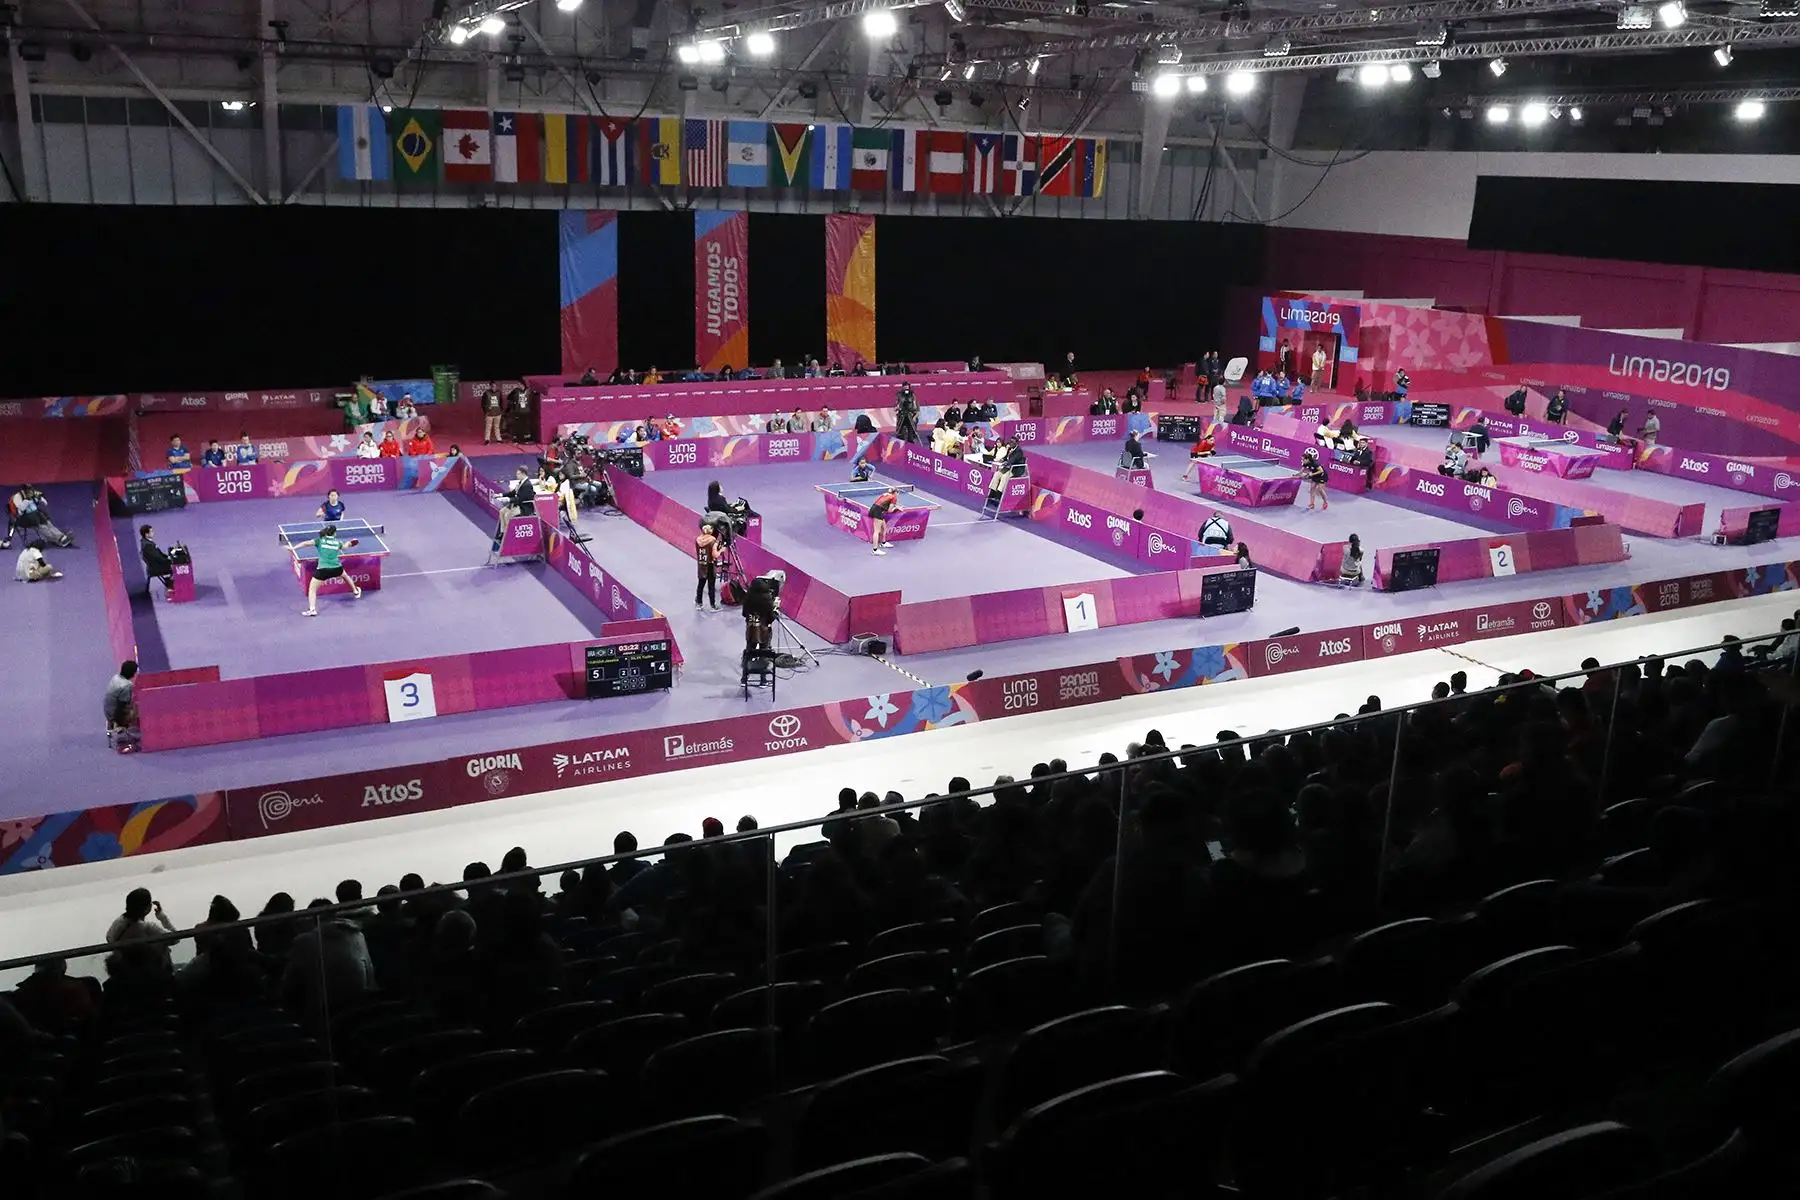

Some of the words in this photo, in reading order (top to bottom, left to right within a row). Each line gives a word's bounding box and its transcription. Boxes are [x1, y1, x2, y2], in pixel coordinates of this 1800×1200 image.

[706, 240, 721, 337] JUGAMOS
[724, 256, 739, 324] TODOS
[1236, 433, 1259, 445] LATAM
[669, 453, 697, 464] 2019
[768, 447, 800, 457] SPORTS
[346, 463, 385, 475] PANAM
[1726, 461, 1755, 477] GLORIA
[217, 481, 253, 494] 2019
[346, 474, 386, 486] SPORTS
[1463, 484, 1491, 503] GLORIA
[514, 529, 534, 538] 2019
[1106, 515, 1131, 537] GLORIA
[1497, 550, 1509, 568] 2
[1659, 593, 1680, 607] 2019
[1075, 600, 1087, 621] 1
[1373, 622, 1403, 640] GLORIA
[1427, 620, 1459, 633] LATAM
[1530, 619, 1556, 629] TOYOTA
[1428, 630, 1460, 641] AIRLINES
[592, 669, 600, 679] 5
[658, 662, 666, 672] 4
[1059, 672, 1099, 688] PANAM
[400, 682, 420, 707] 3
[1059, 683, 1100, 700] SPORTS
[1004, 692, 1039, 710] 2019
[664, 735, 734, 757] Petramás
[764, 737, 808, 752] TOYOTA
[572, 746, 630, 766] LATAM
[466, 752, 522, 778] GLORIA
[573, 760, 631, 777] AIRLINES
[258, 789, 323, 829] Perú
